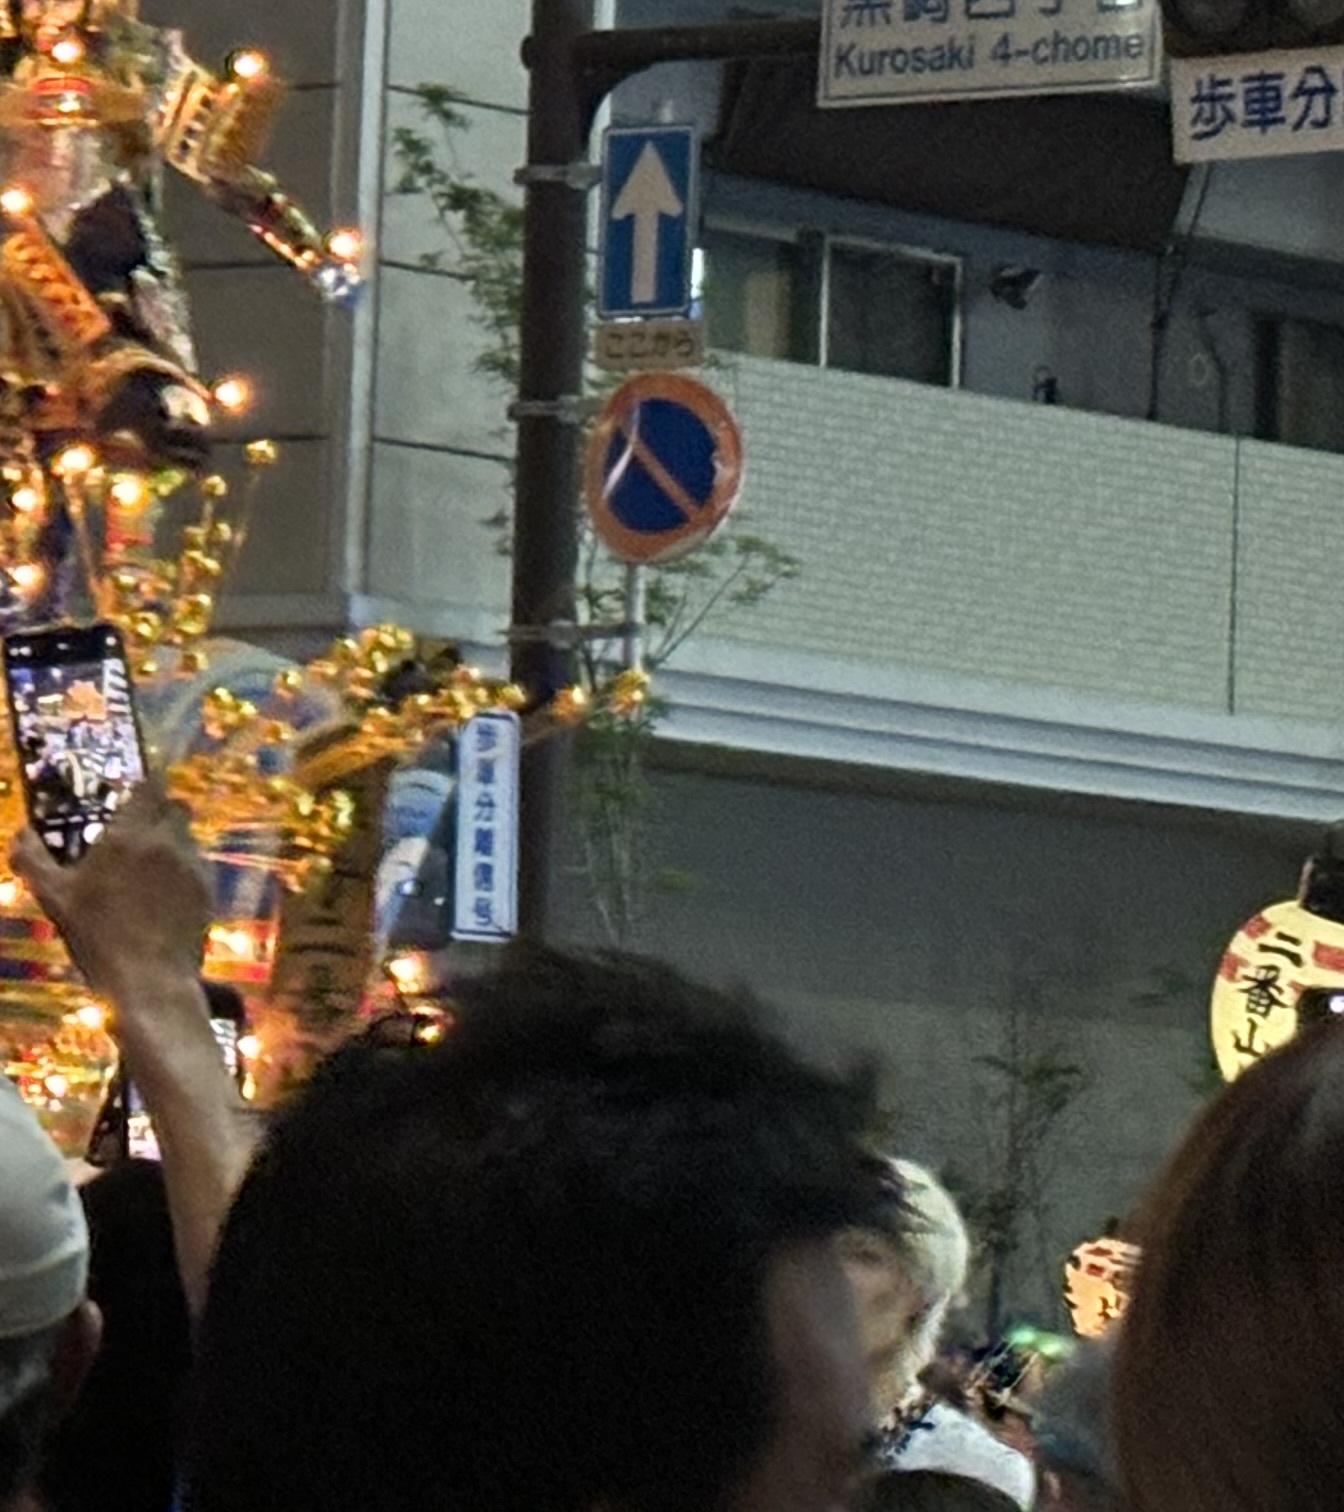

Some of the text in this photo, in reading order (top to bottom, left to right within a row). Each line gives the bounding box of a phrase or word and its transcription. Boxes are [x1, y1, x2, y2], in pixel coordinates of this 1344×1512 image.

[833, 29, 1144, 80] Kurosaki 4-chome
[1189, 64, 1344, 141] 歩車分
